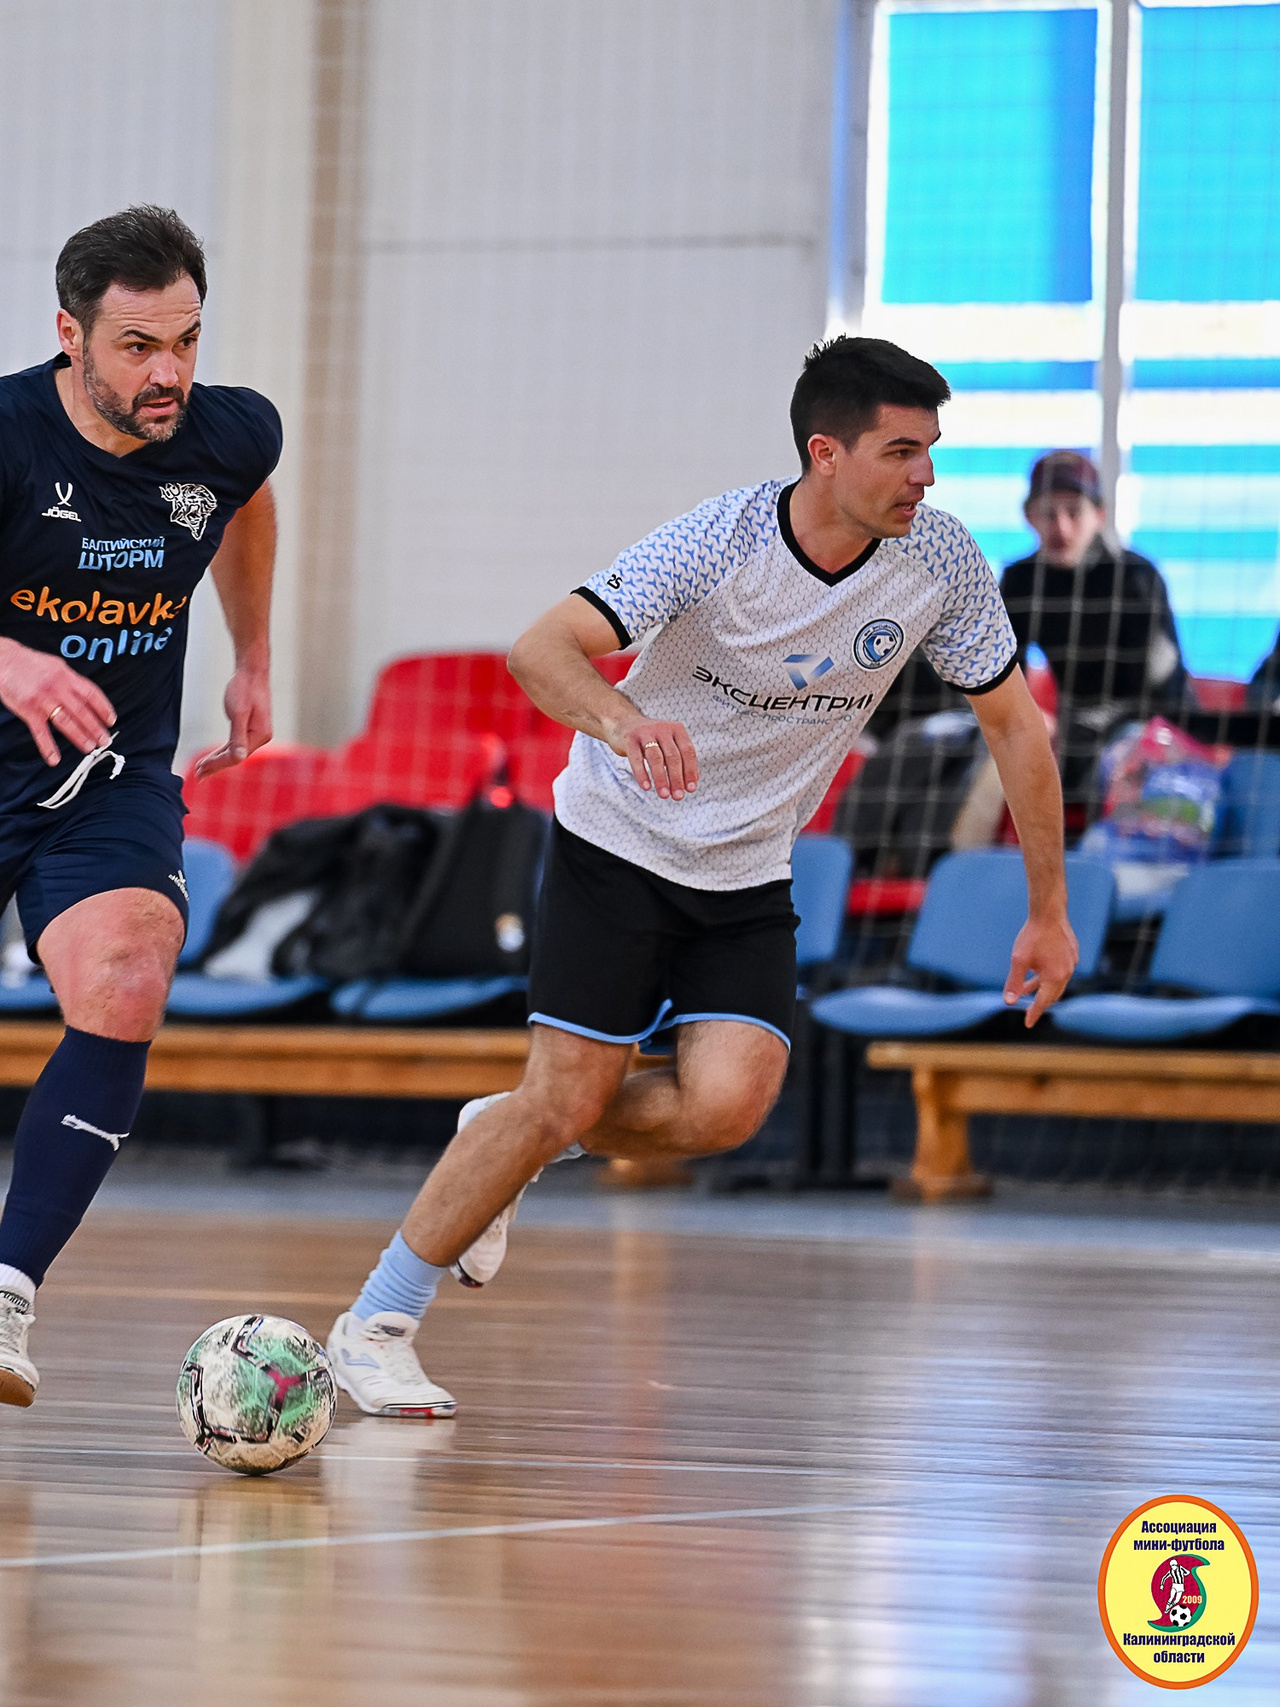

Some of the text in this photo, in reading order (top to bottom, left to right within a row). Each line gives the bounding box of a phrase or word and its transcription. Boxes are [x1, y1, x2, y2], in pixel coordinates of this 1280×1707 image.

[81, 536, 166, 552] БАЛТИЙСКИЙ
[77, 549, 165, 572] ШТОРМ
[60, 626, 173, 664] online
